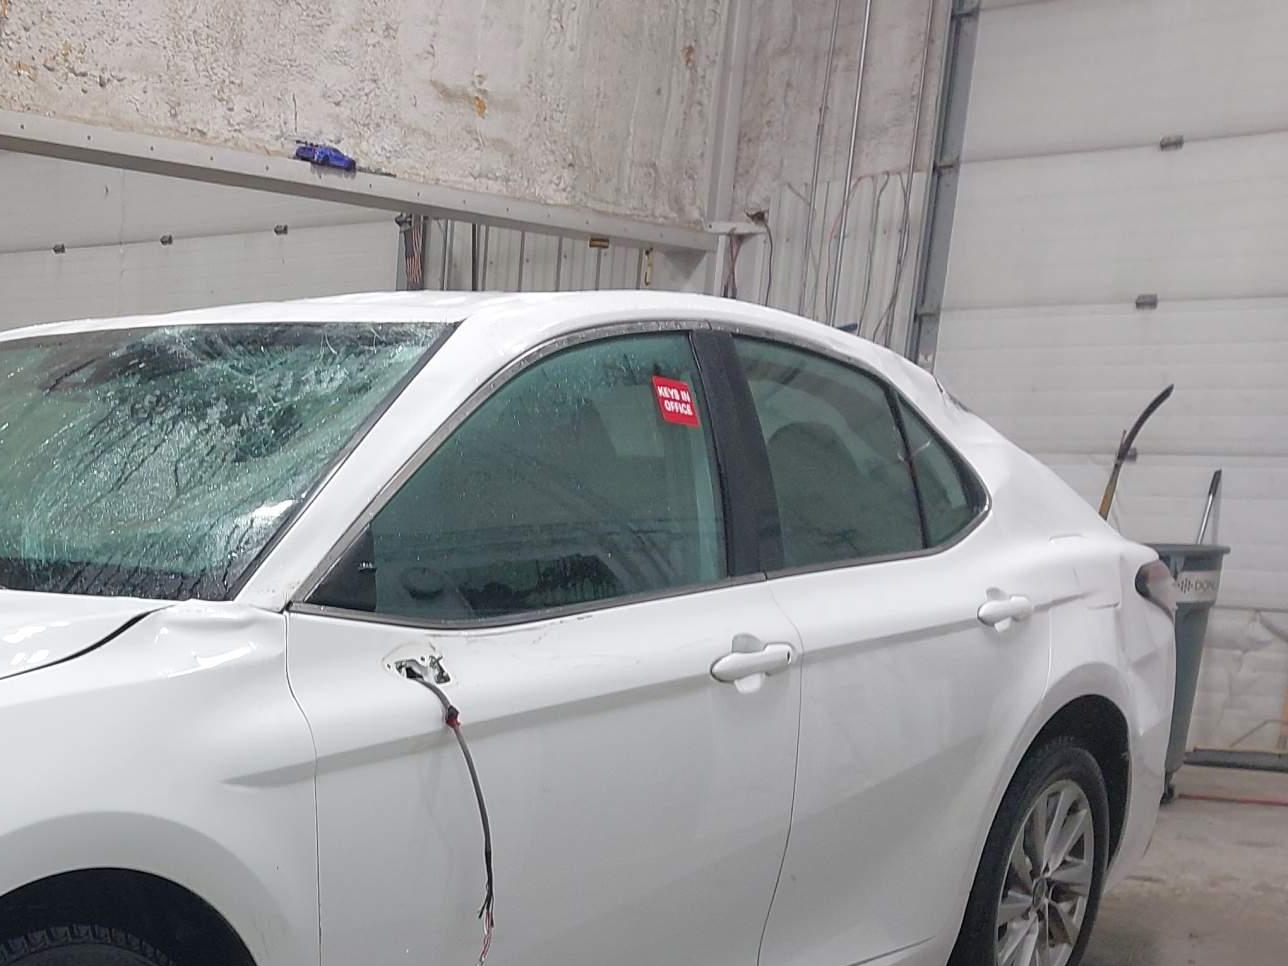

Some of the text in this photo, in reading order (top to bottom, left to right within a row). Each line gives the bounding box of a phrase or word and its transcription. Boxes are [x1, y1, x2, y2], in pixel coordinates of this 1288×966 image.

[657, 386, 691, 403] KEYS IN
[664, 400, 693, 416] OFFICE
